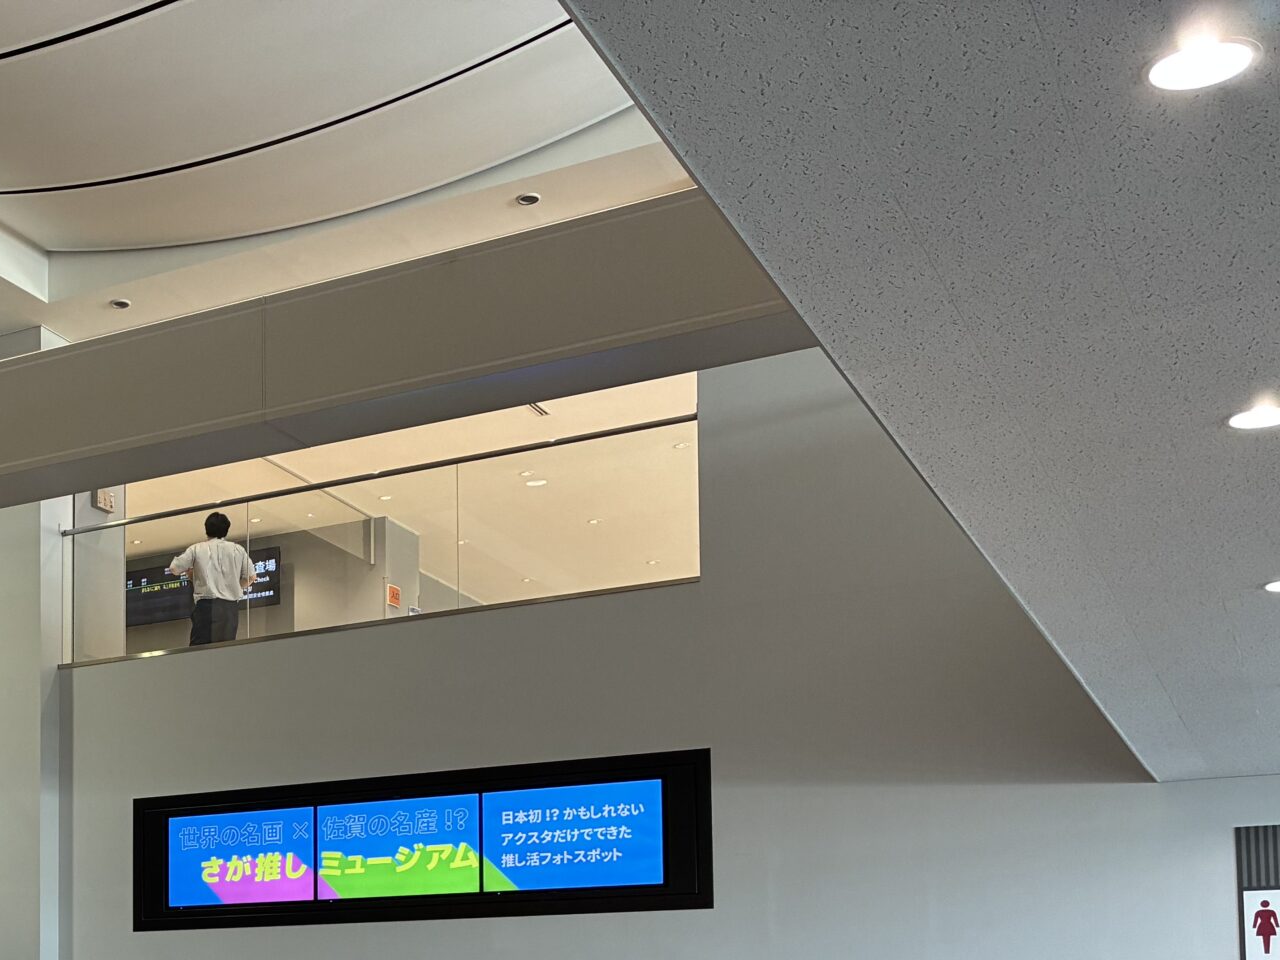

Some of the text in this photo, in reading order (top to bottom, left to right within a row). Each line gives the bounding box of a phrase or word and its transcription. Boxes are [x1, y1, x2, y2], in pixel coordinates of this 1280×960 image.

[179, 821, 283, 850] 世界の名画
[501, 825, 632, 846] アクスタだけでできた
[201, 842, 479, 883] さが推し ミュージアム
[501, 848, 622, 868] 推し活フォトスポット
